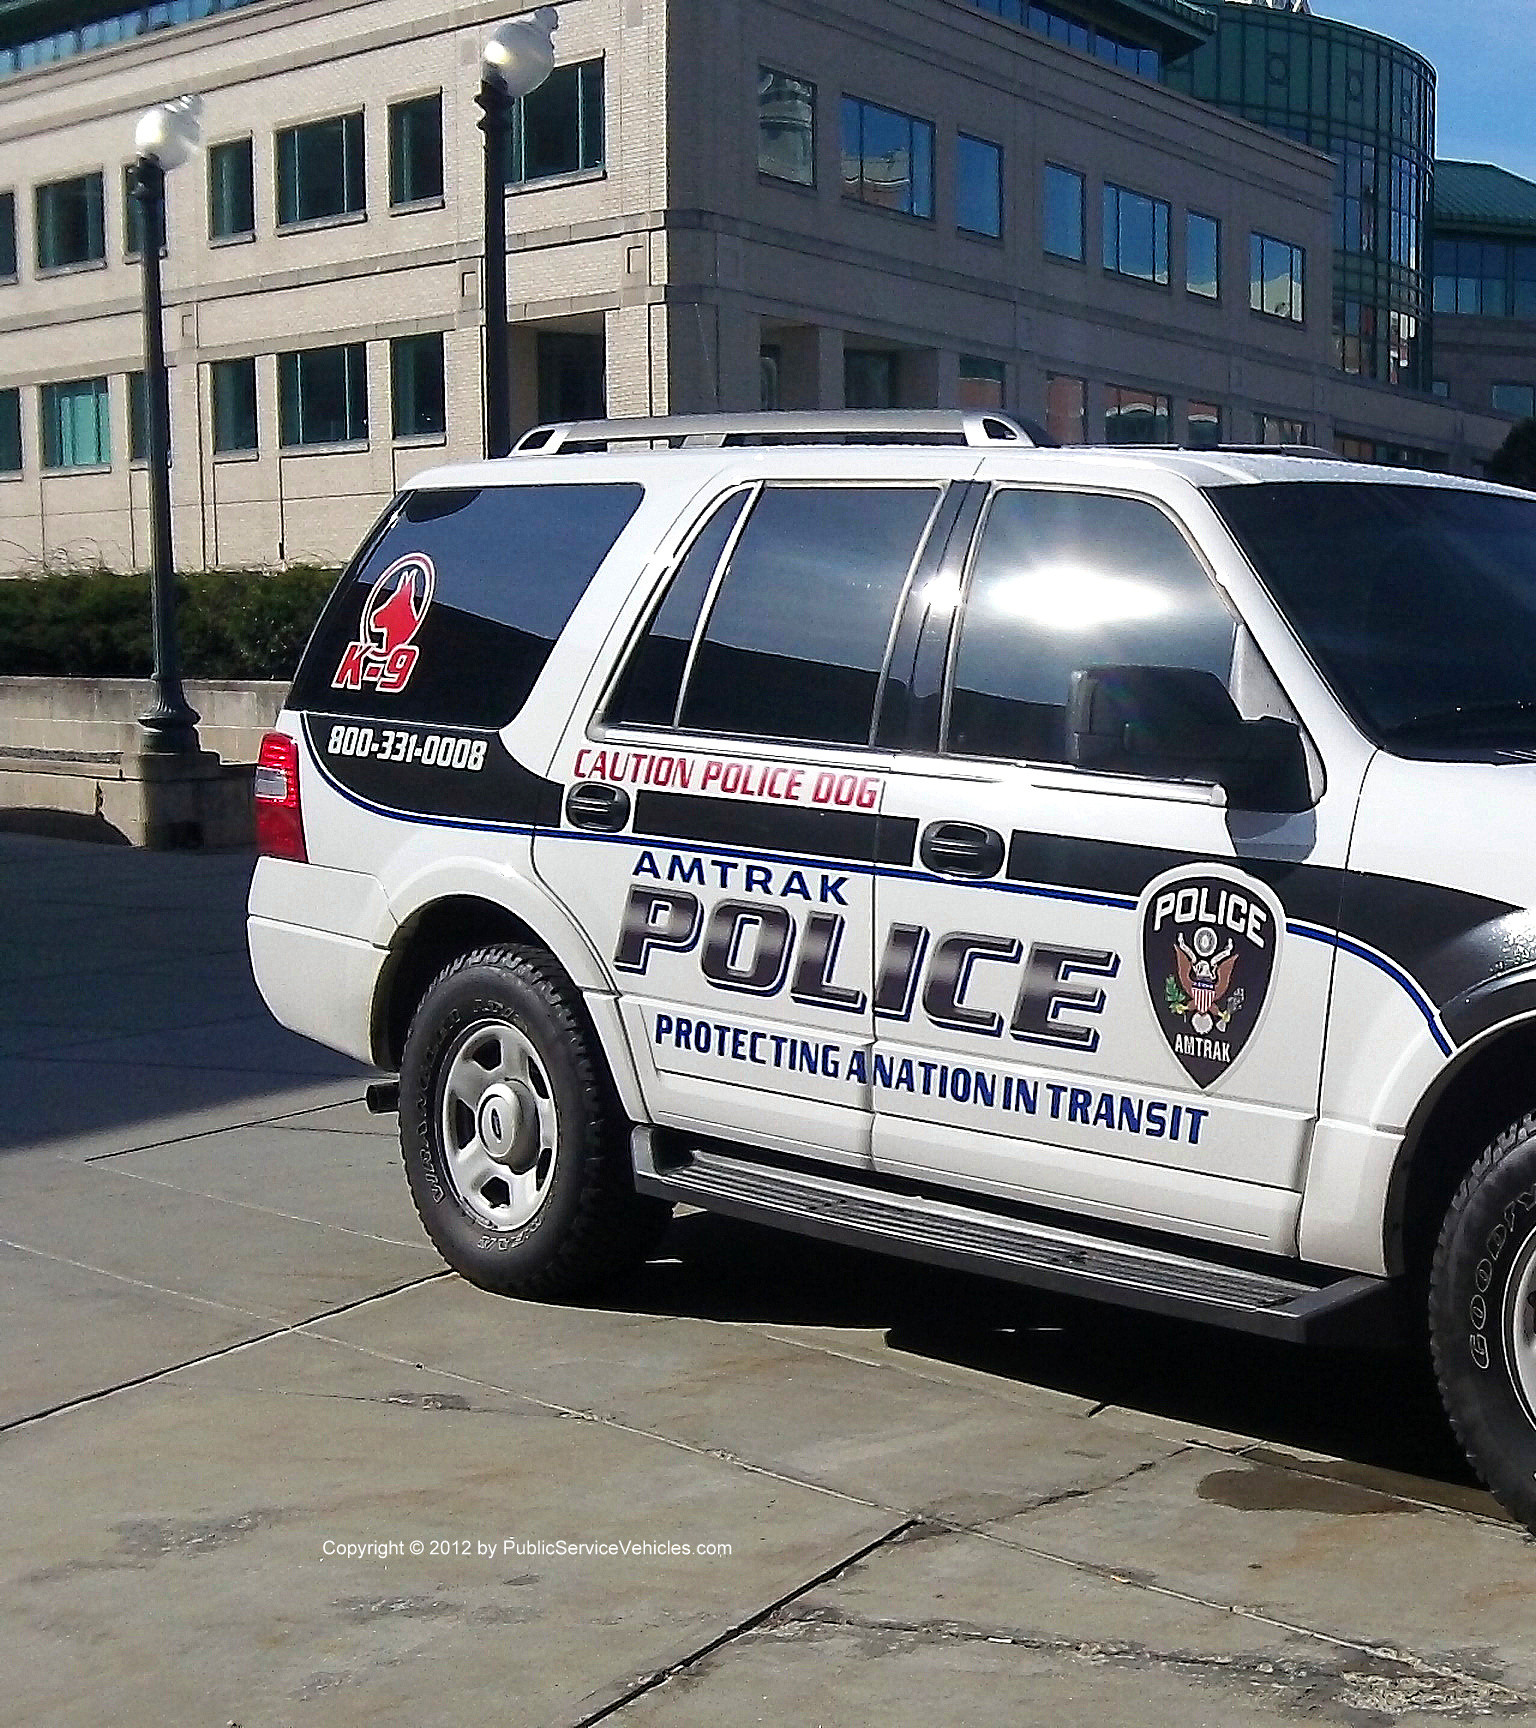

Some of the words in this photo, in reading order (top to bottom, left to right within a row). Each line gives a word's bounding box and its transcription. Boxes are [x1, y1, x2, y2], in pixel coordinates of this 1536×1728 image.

[331, 641, 420, 693] K-9
[328, 725, 488, 771] 800-331-0008
[573, 748, 696, 789] CAUTION
[700, 760, 806, 800] POLICE
[811, 772, 882, 809] DOG
[631, 850, 850, 906] AMTRAK
[1154, 887, 1267, 948] POLICE
[613, 883, 1120, 1053] POLICE
[1174, 1033, 1231, 1063] AMTRAK
[655, 1013, 840, 1080] PROTECTING
[845, 1049, 869, 1086] A
[873, 1053, 997, 1108] NATION
[1002, 1075, 1039, 1116] IN
[1046, 1083, 1209, 1145] TRANSIT
